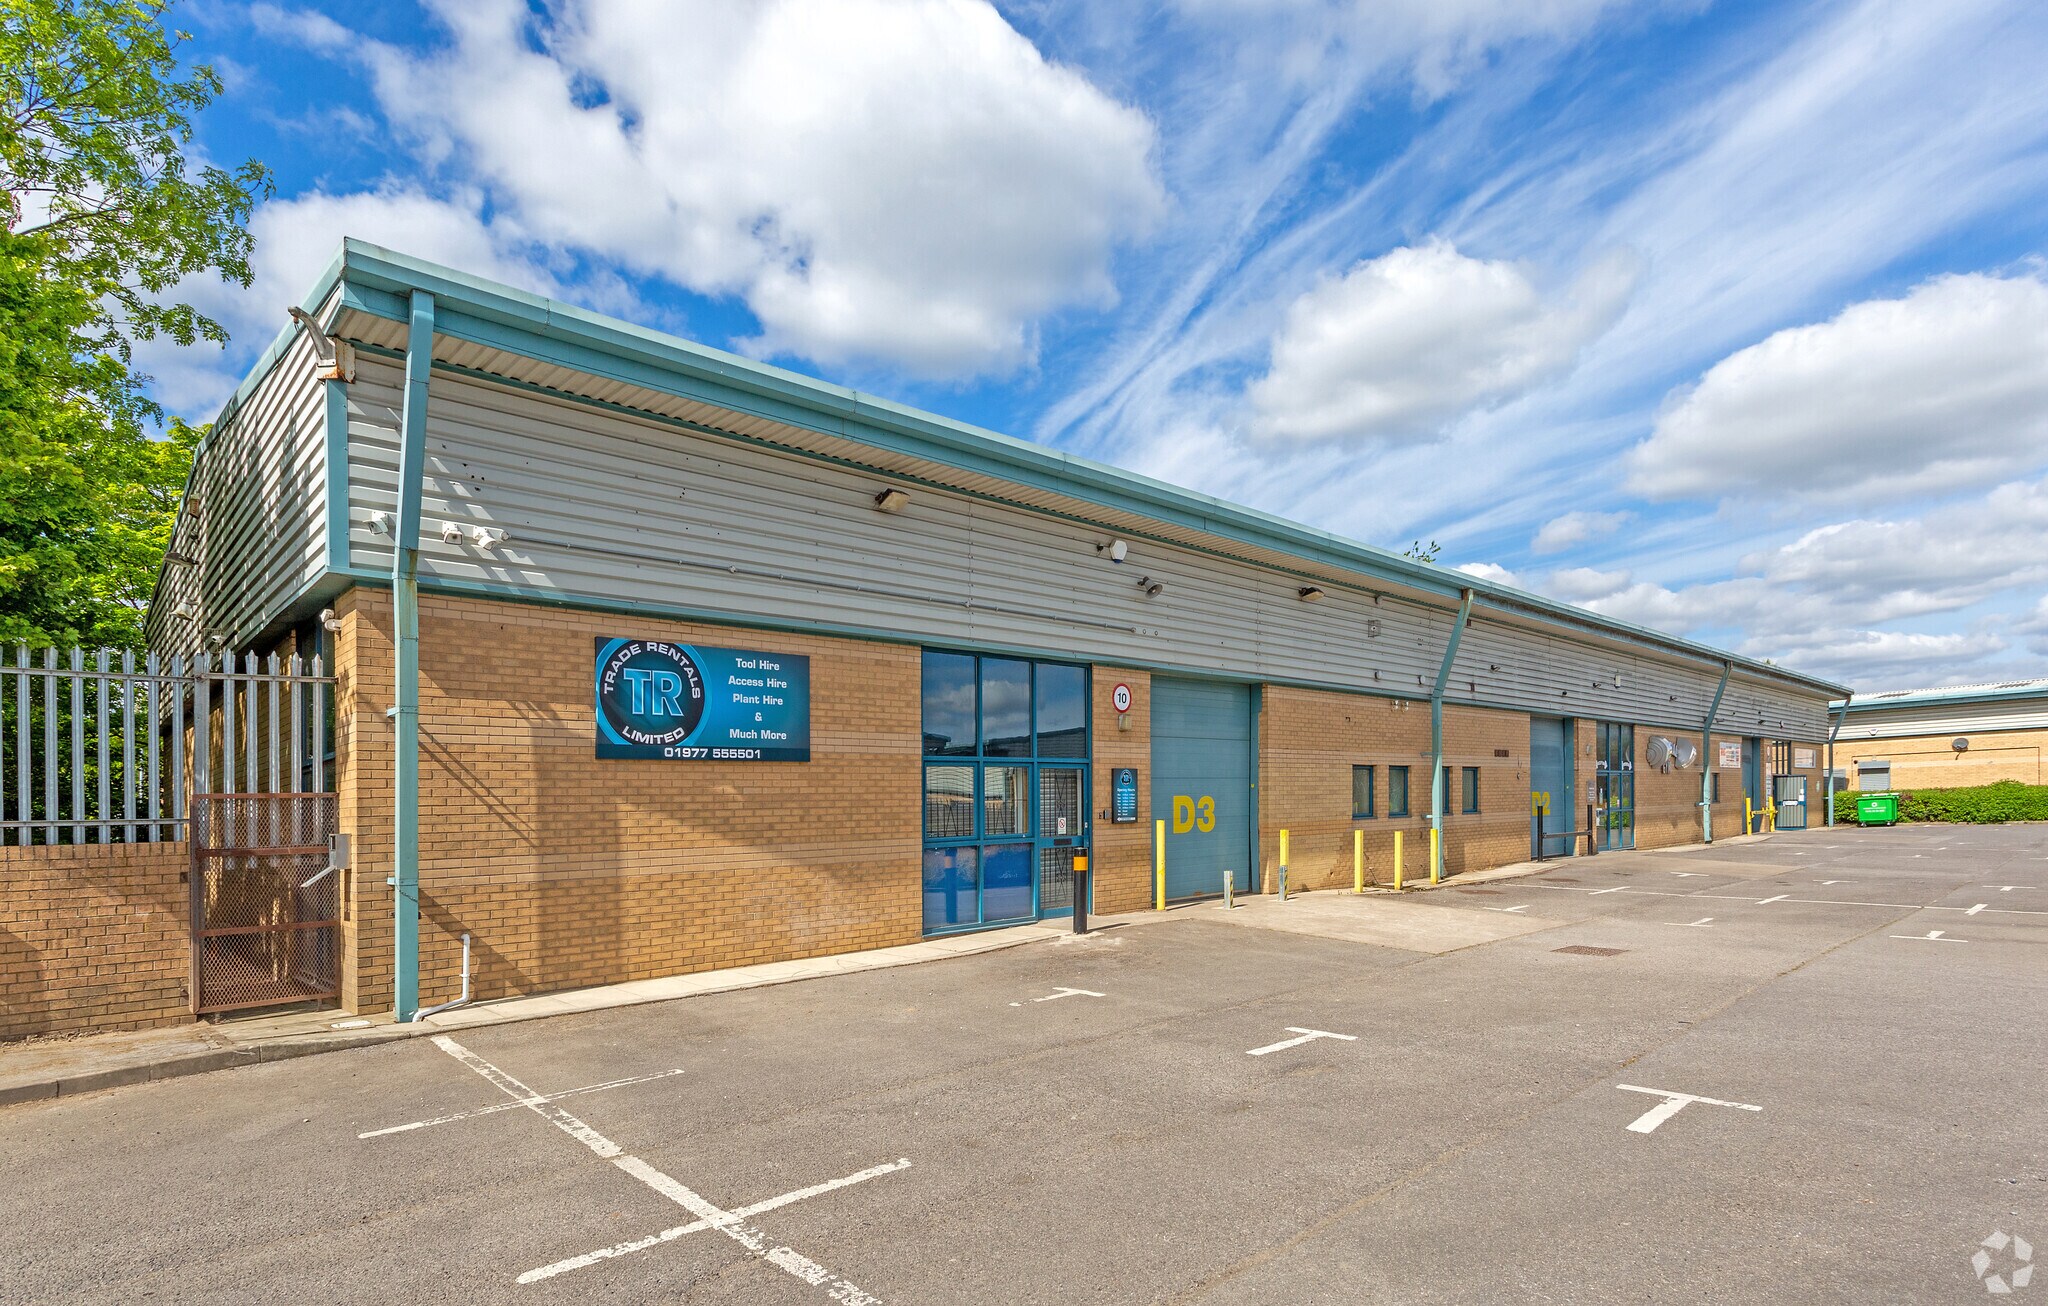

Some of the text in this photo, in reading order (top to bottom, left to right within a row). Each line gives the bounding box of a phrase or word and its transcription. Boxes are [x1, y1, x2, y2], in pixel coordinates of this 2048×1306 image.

[604, 641, 701, 699] TRADE RENTALS
[735, 658, 780, 671] Tool Hire
[728, 675, 787, 689] Access Hire
[623, 667, 684, 717] TR
[1117, 692, 1127, 704] 10
[732, 693, 784, 706] Plant Hire
[754, 712, 763, 722] &
[622, 725, 685, 745] LIMITED
[729, 728, 787, 740] Much More
[664, 747, 761, 759] 01977 555501
[1531, 791, 1551, 816] D2
[1172, 795, 1216, 834] D3
